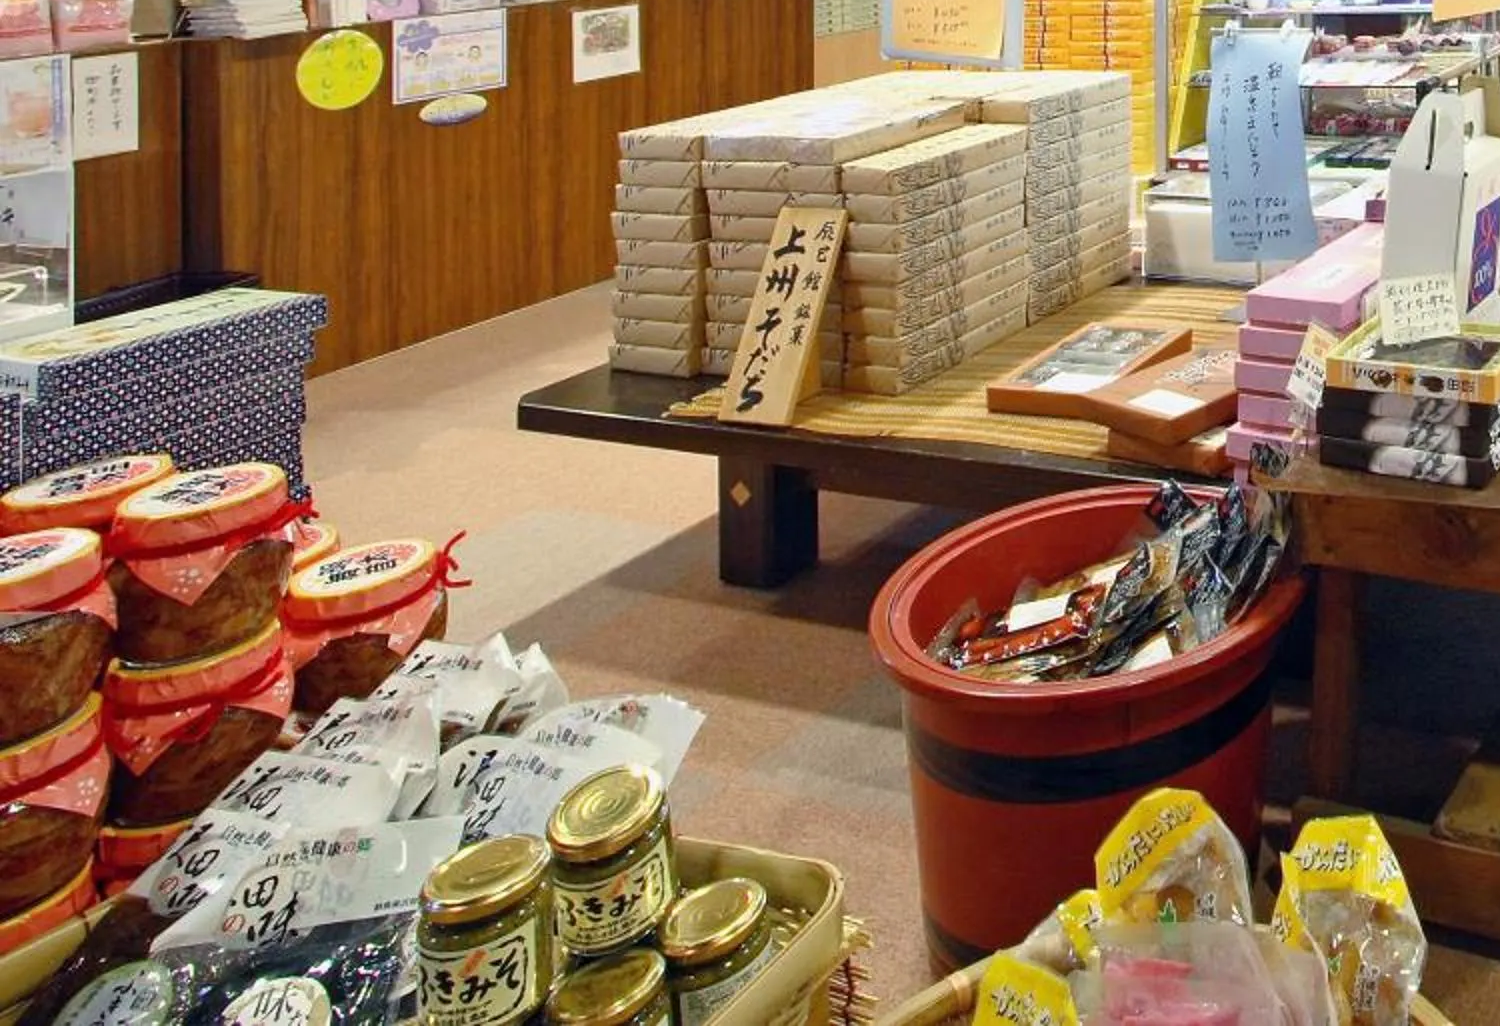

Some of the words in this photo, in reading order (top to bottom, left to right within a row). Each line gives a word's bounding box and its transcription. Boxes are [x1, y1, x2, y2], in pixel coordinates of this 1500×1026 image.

[736, 225, 807, 413] 上州そだち
